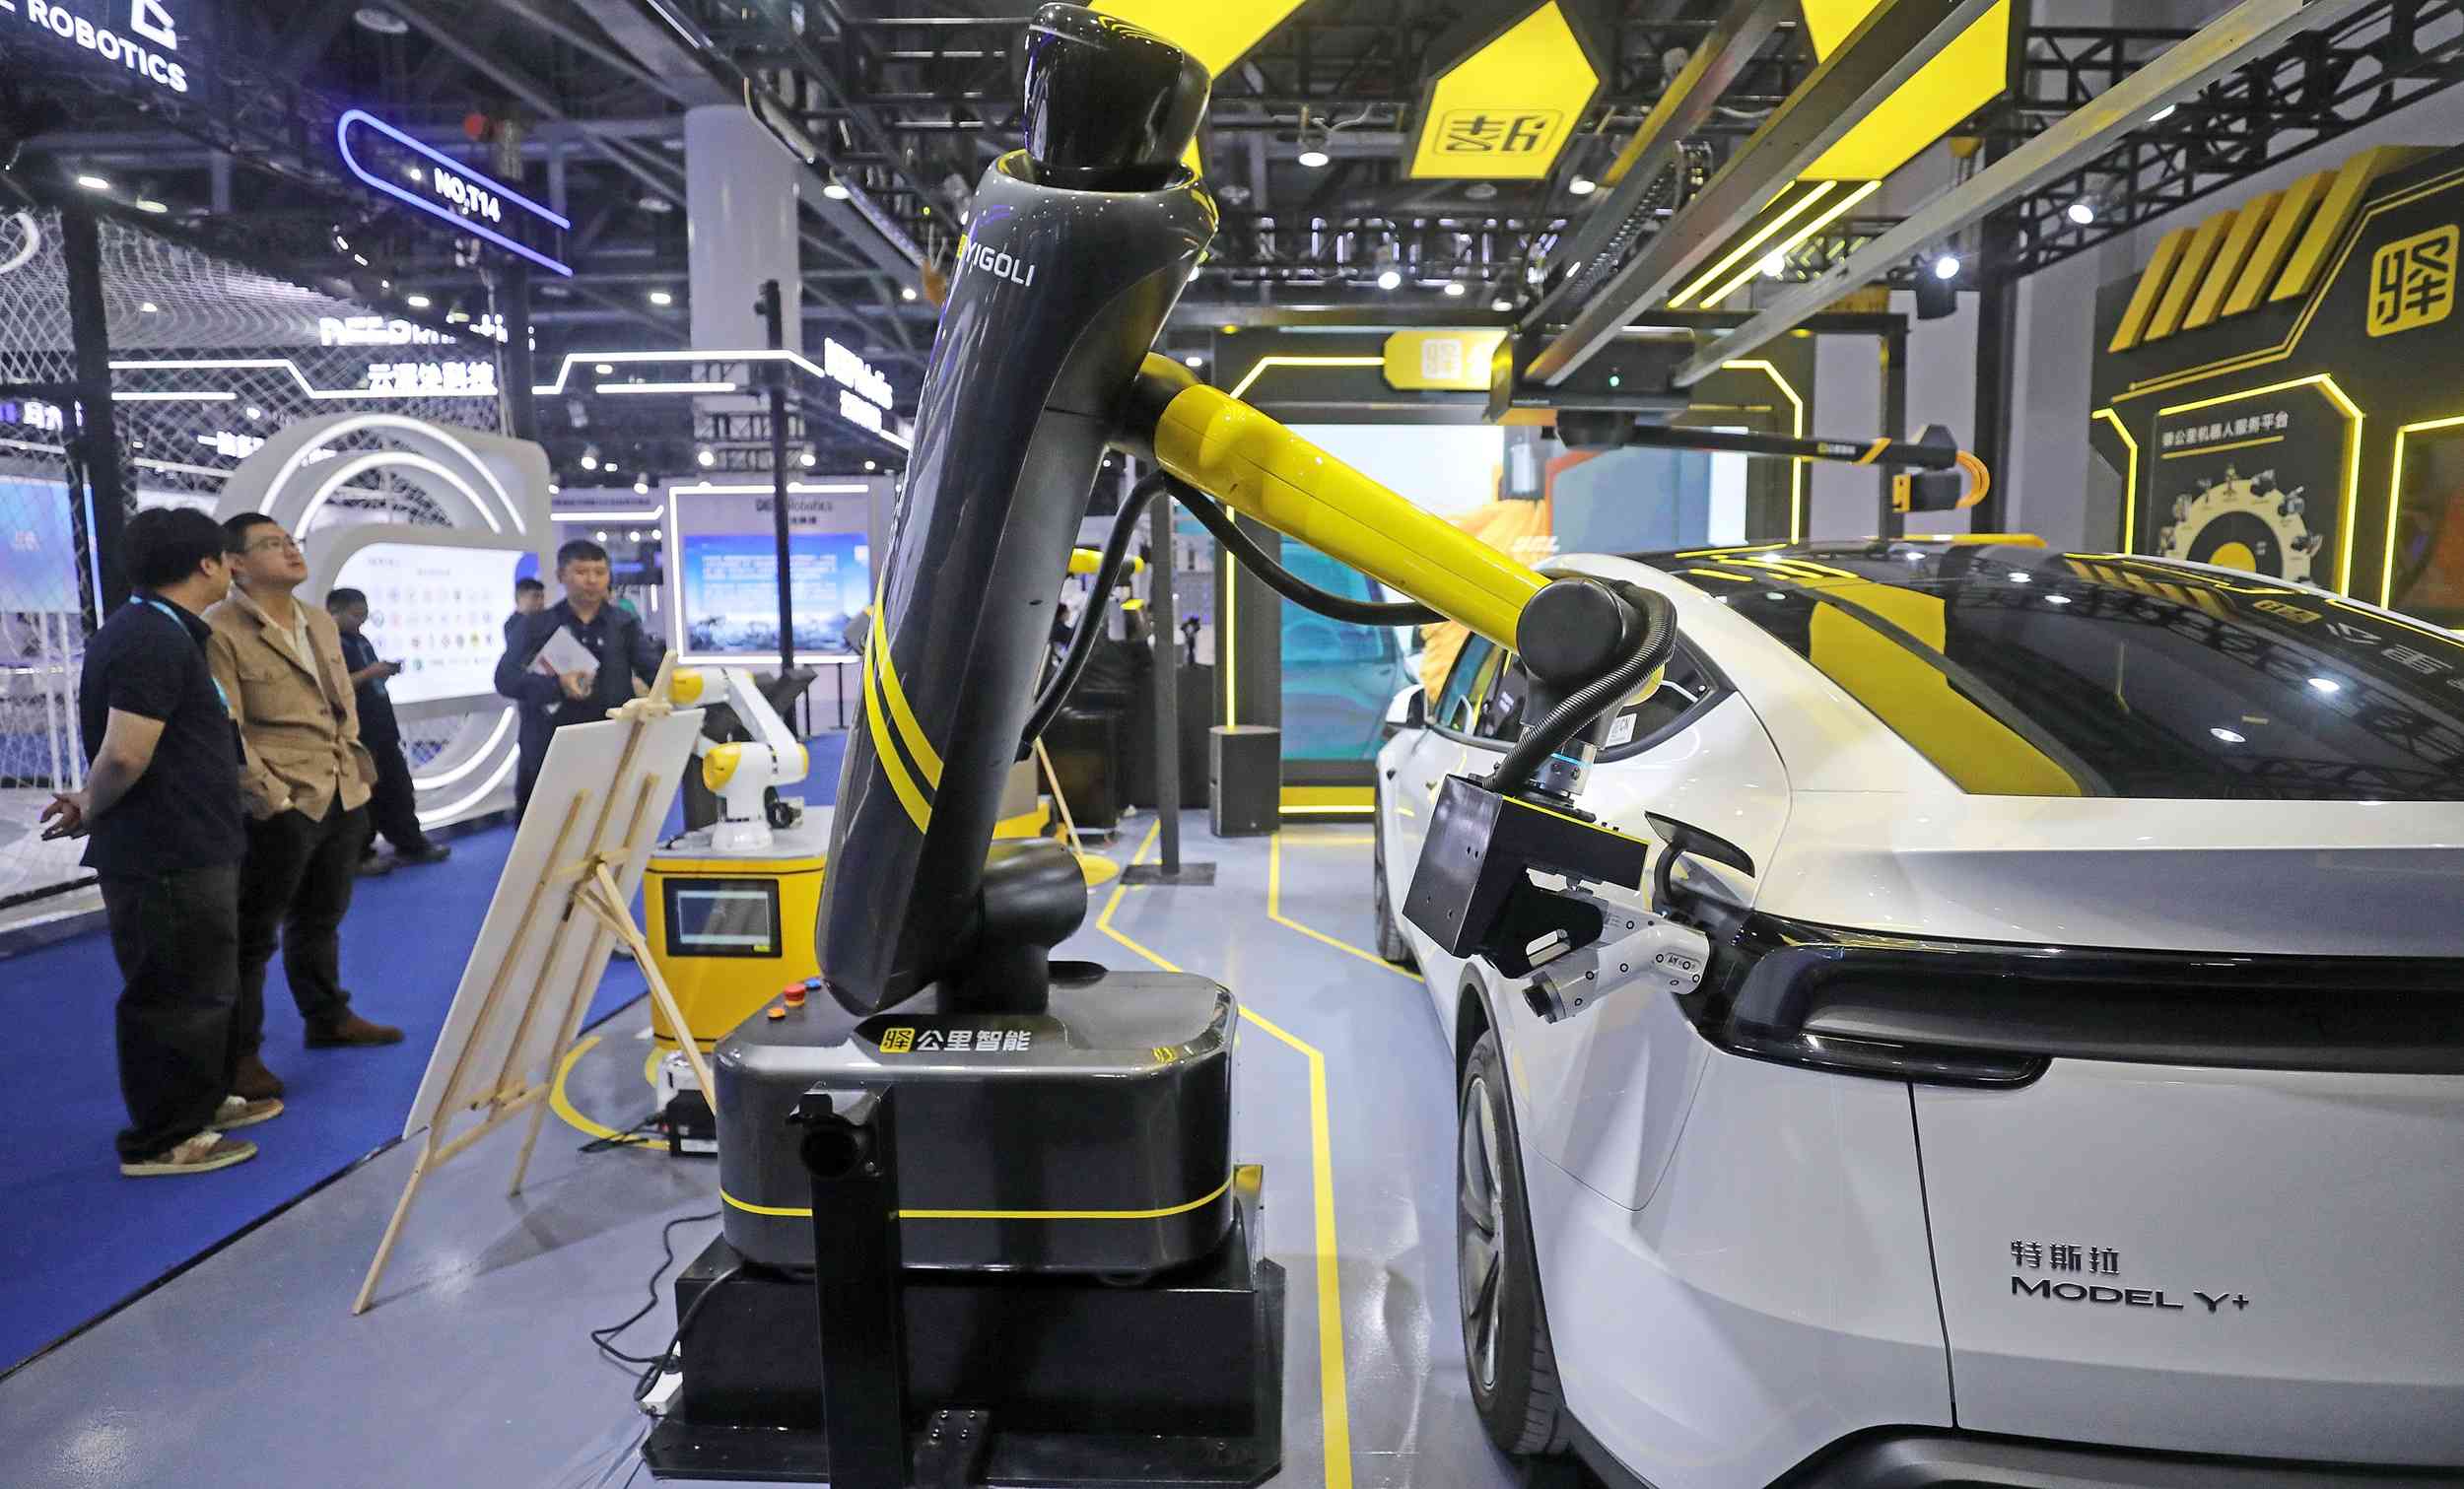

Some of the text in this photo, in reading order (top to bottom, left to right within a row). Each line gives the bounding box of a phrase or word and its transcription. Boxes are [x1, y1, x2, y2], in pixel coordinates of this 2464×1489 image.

[27, 0, 188, 92] ROBOTICS
[966, 241, 1036, 287] YIGOLI
[2011, 1238, 2121, 1275] 特斯拉
[2011, 1275, 2250, 1314] MODEL Y+
